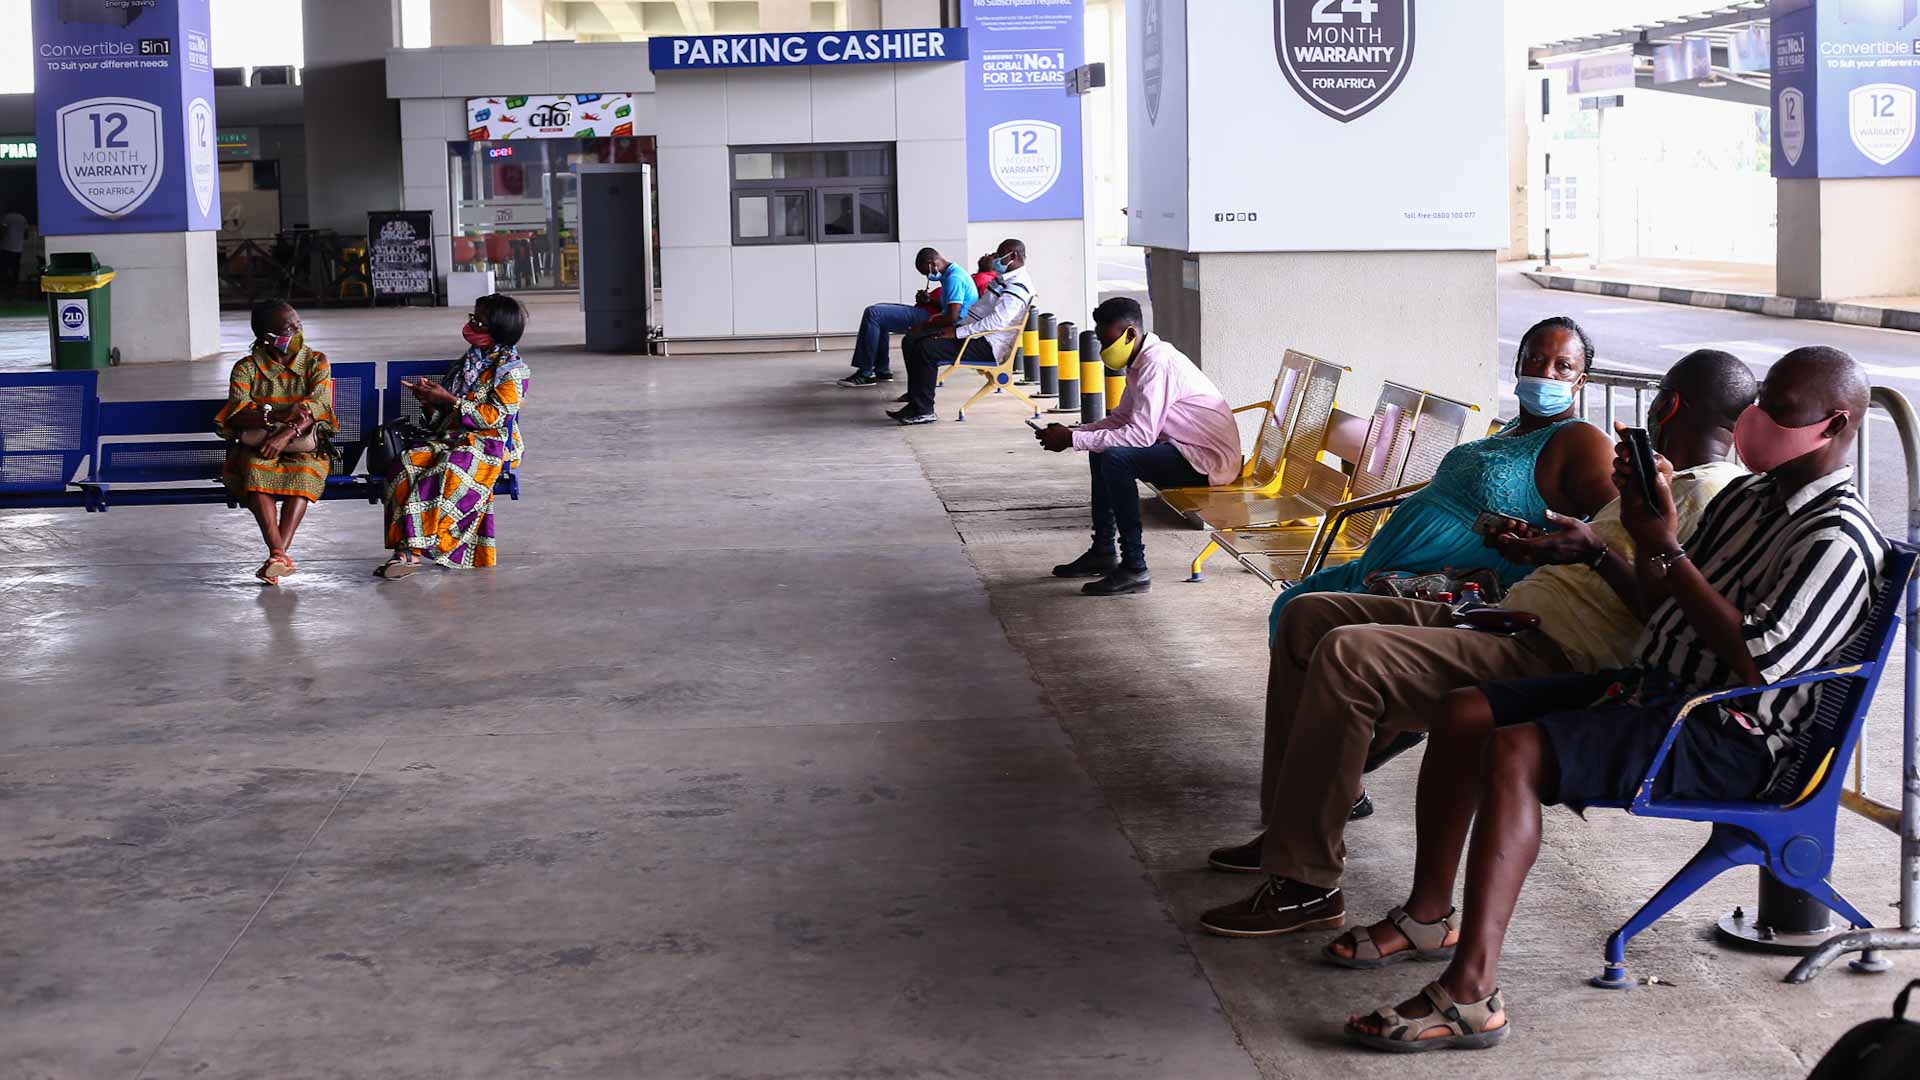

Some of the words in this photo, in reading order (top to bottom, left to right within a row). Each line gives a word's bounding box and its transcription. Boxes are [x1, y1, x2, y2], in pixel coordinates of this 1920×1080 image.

[1306, 27, 1382, 44] MONTH
[40, 42, 134, 57] Convertible
[141, 41, 169, 54] 5in1
[673, 37, 808, 65] PARKING
[817, 32, 946, 61] CASHIER
[1293, 46, 1396, 63] WARRANTY
[1820, 41, 1909, 55] Convertible
[61, 61, 77, 70] Suit
[79, 62, 98, 72] your
[100, 60, 139, 69] different
[141, 60, 169, 68] needs
[983, 61, 1024, 71] GLOBAL
[1023, 53, 1065, 70] No.1
[1857, 60, 1876, 70] your
[1877, 58, 1912, 67] different
[983, 73, 1009, 83] FOR
[1011, 72, 1023, 83] 12
[1025, 71, 1065, 82] YEARS
[1312, 78, 1335, 89] FOR
[1336, 78, 1377, 89] AFRICA
[1785, 97, 1796, 121] 12
[1870, 94, 1895, 118] 12
[529, 102, 572, 127] CHO!
[89, 112, 129, 149] 12
[196, 112, 206, 147] 12
[1859, 128, 1906, 136] WARRANTY
[1011, 130, 1038, 154] 12
[82, 150, 139, 164] MONTH
[74, 164, 148, 177] WARRANTY
[1000, 165, 1050, 174] WARRANTY
[88, 187, 105, 196] FOR
[106, 187, 135, 196] AFRICA
[64, 312, 83, 322] ZLD
